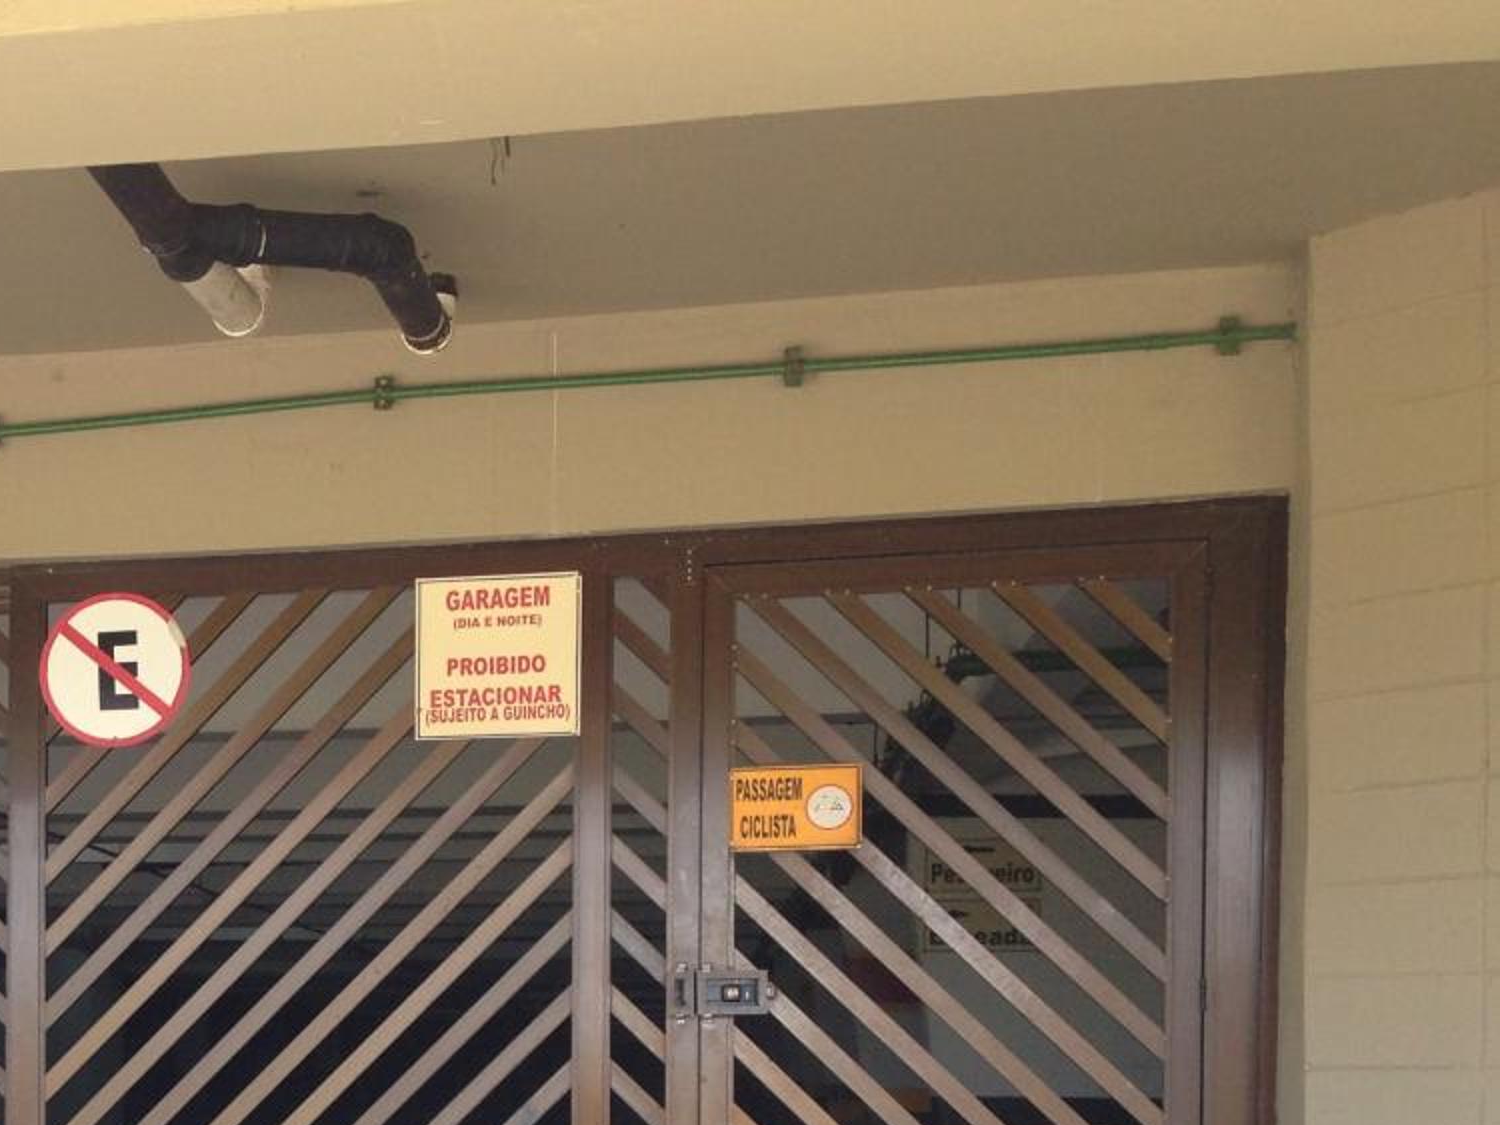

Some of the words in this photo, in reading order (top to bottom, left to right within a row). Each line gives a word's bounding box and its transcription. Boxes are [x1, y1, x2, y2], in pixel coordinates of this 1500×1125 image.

[445, 586, 550, 611] GARAGEM
[453, 617, 480, 630] (DIA
[484, 616, 493, 628] E
[499, 614, 542, 628] NOITE)
[98, 630, 139, 711] E
[447, 654, 546, 676] PROIBIDO
[430, 685, 562, 708] ESTACIONAR
[425, 706, 487, 727] (SUJEITO
[490, 707, 499, 721] A
[503, 704, 570, 721] GUINCHO)
[735, 777, 803, 801] PASSAGEM
[740, 815, 797, 839] CICLISTA
